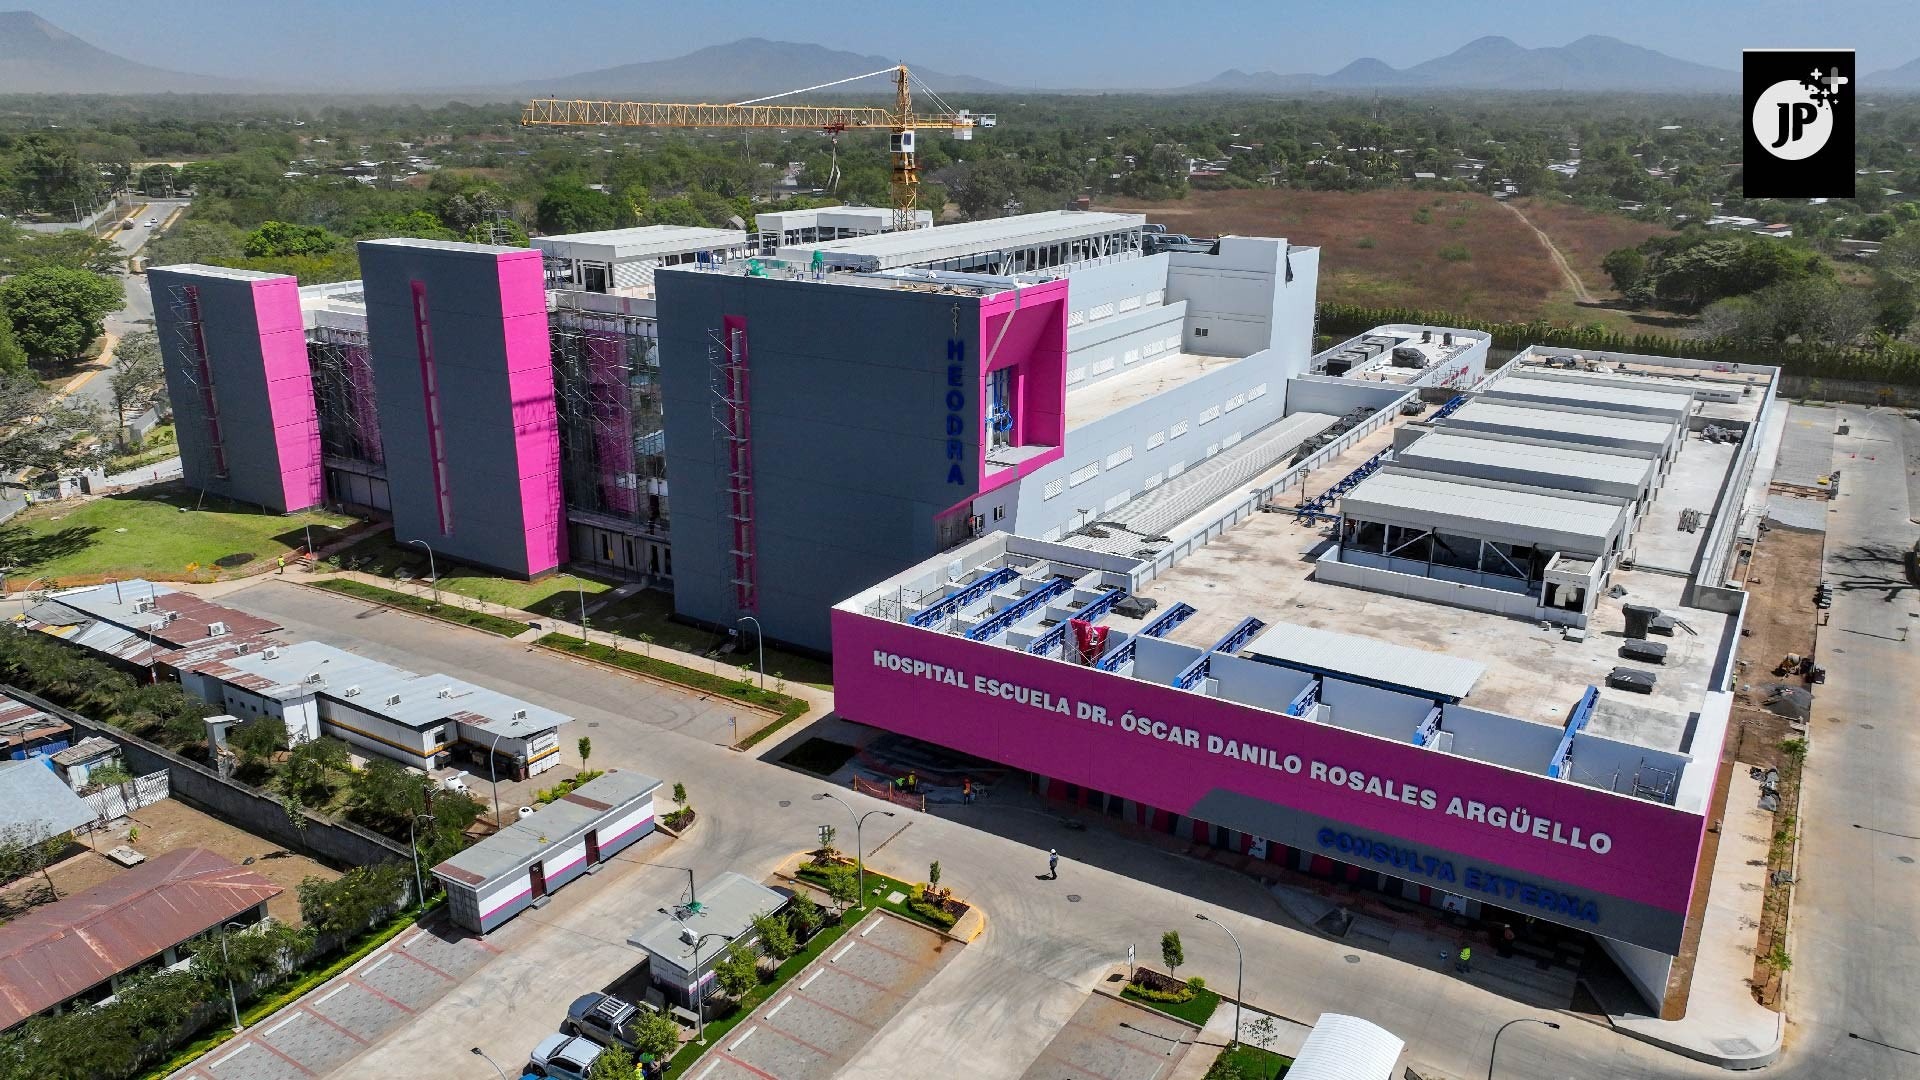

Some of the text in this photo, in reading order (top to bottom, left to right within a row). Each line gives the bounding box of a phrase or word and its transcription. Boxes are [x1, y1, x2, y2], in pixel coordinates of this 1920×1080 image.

[946, 339, 965, 486] HEODRA
[874, 650, 1612, 854] HOSPITAL ESCUELA DR. ÓSCAR DANILO ROSALES ARGÜELLO
[1317, 828, 1599, 922] CONSULTA EXTERNA
